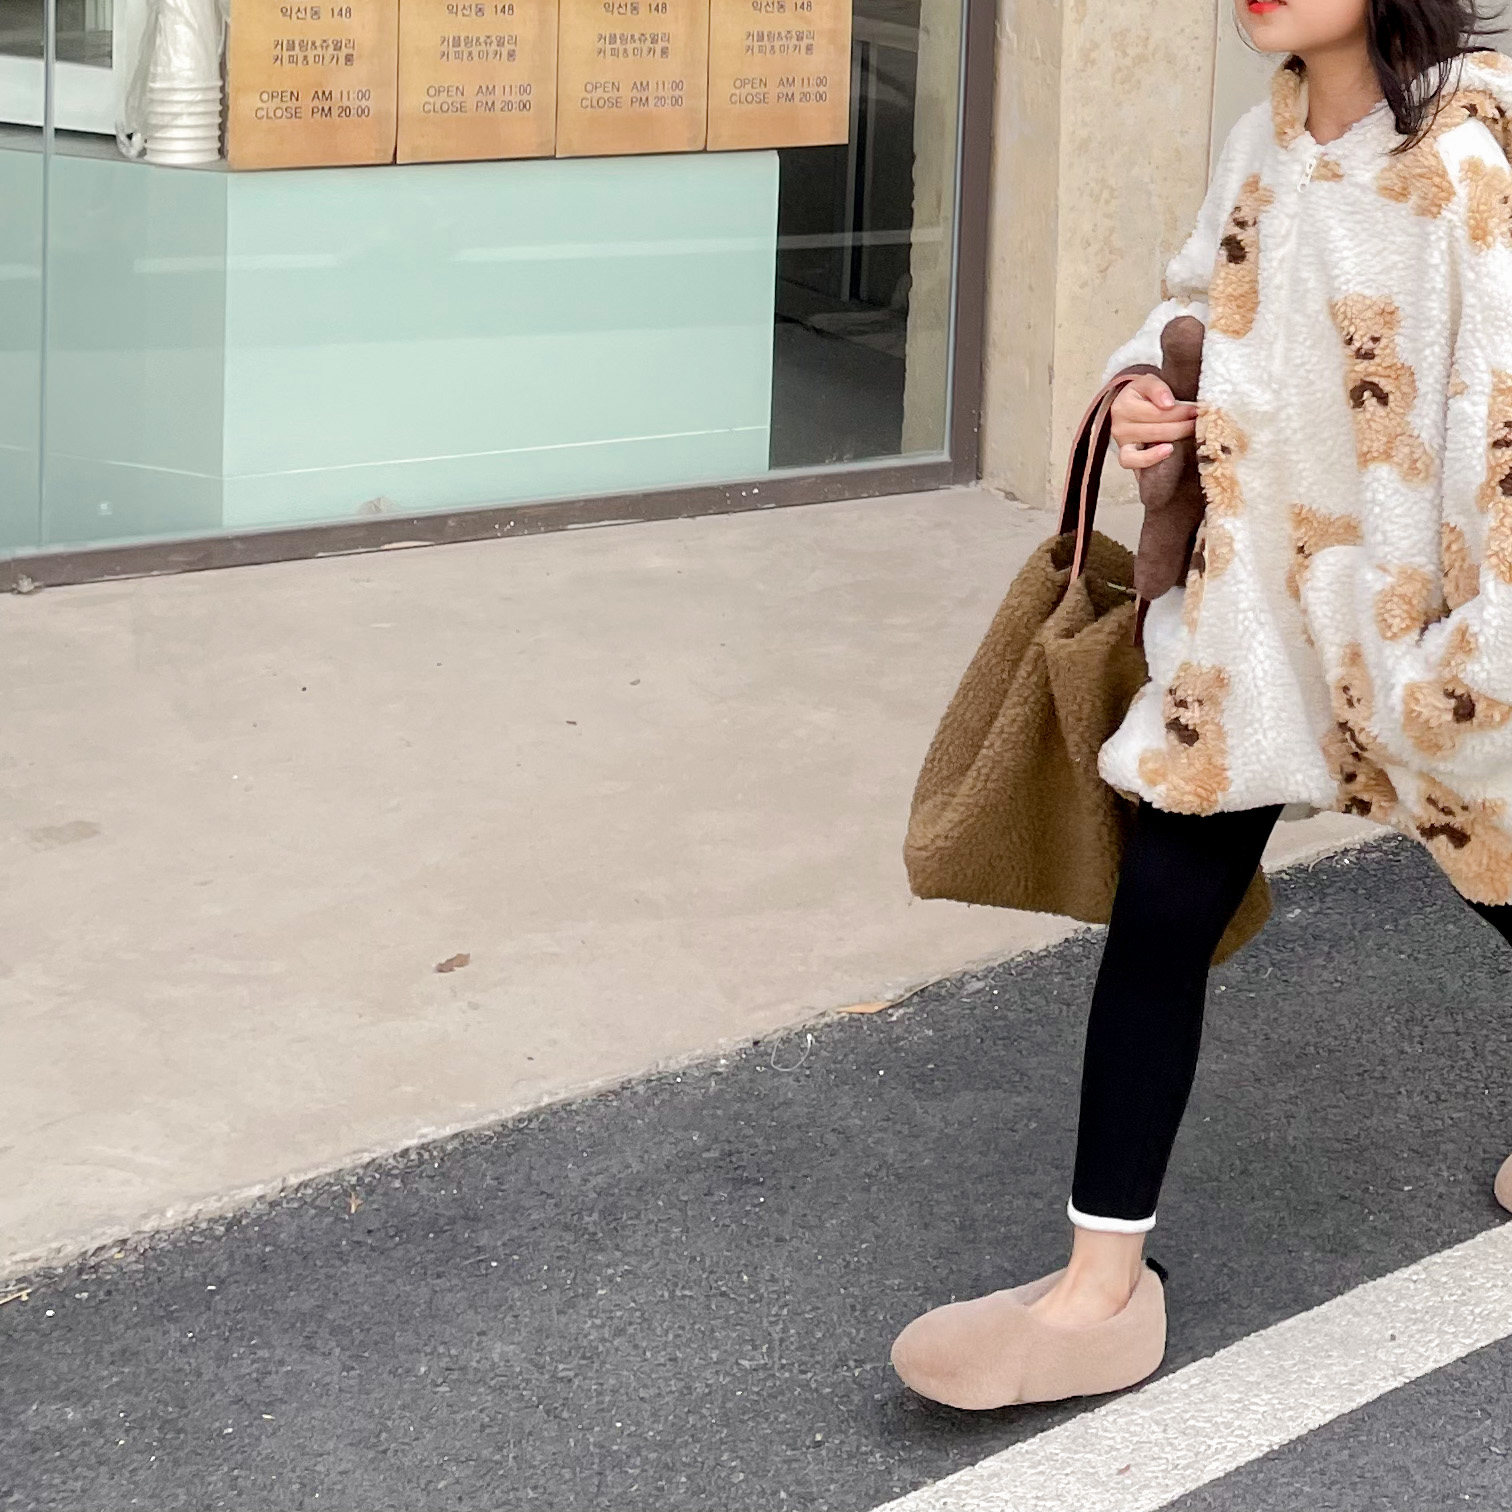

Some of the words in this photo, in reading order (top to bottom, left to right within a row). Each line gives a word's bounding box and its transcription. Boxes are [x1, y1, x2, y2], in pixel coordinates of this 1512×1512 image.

[280, 6, 321, 20] 익선동
[330, 7, 352, 20] 148
[446, 3, 485, 17] 익선동
[494, 4, 515, 16] 148
[603, 2, 640, 15] 익선동
[648, 2, 668, 14] 148
[751, 0, 786, 14] 익선동
[794, 0, 813, 12] 148
[584, 81, 621, 94] OPEN
[630, 80, 650, 93] AM
[655, 80, 684, 92] 11:00
[733, 77, 768, 90] OPEN
[777, 76, 796, 89] AM
[801, 75, 828, 88] 11:00
[259, 90, 300, 104] OPEN
[311, 90, 333, 102] AM
[340, 89, 371, 102] 11:00
[426, 85, 465, 98] OPEN
[476, 84, 496, 97] AM
[502, 83, 532, 96] 11:00
[729, 92, 770, 105] CLOSE
[776, 91, 795, 104] PM
[799, 90, 828, 104] 20:00
[422, 101, 468, 114] CLOSE
[475, 100, 496, 112] PM
[500, 99, 532, 112] 20:00
[580, 96, 623, 109] CLOSE
[630, 96, 650, 108] PM
[653, 95, 684, 108] 20:00
[255, 106, 303, 120] CLOSE
[311, 106, 333, 119] PM
[337, 105, 370, 119] 20:00
